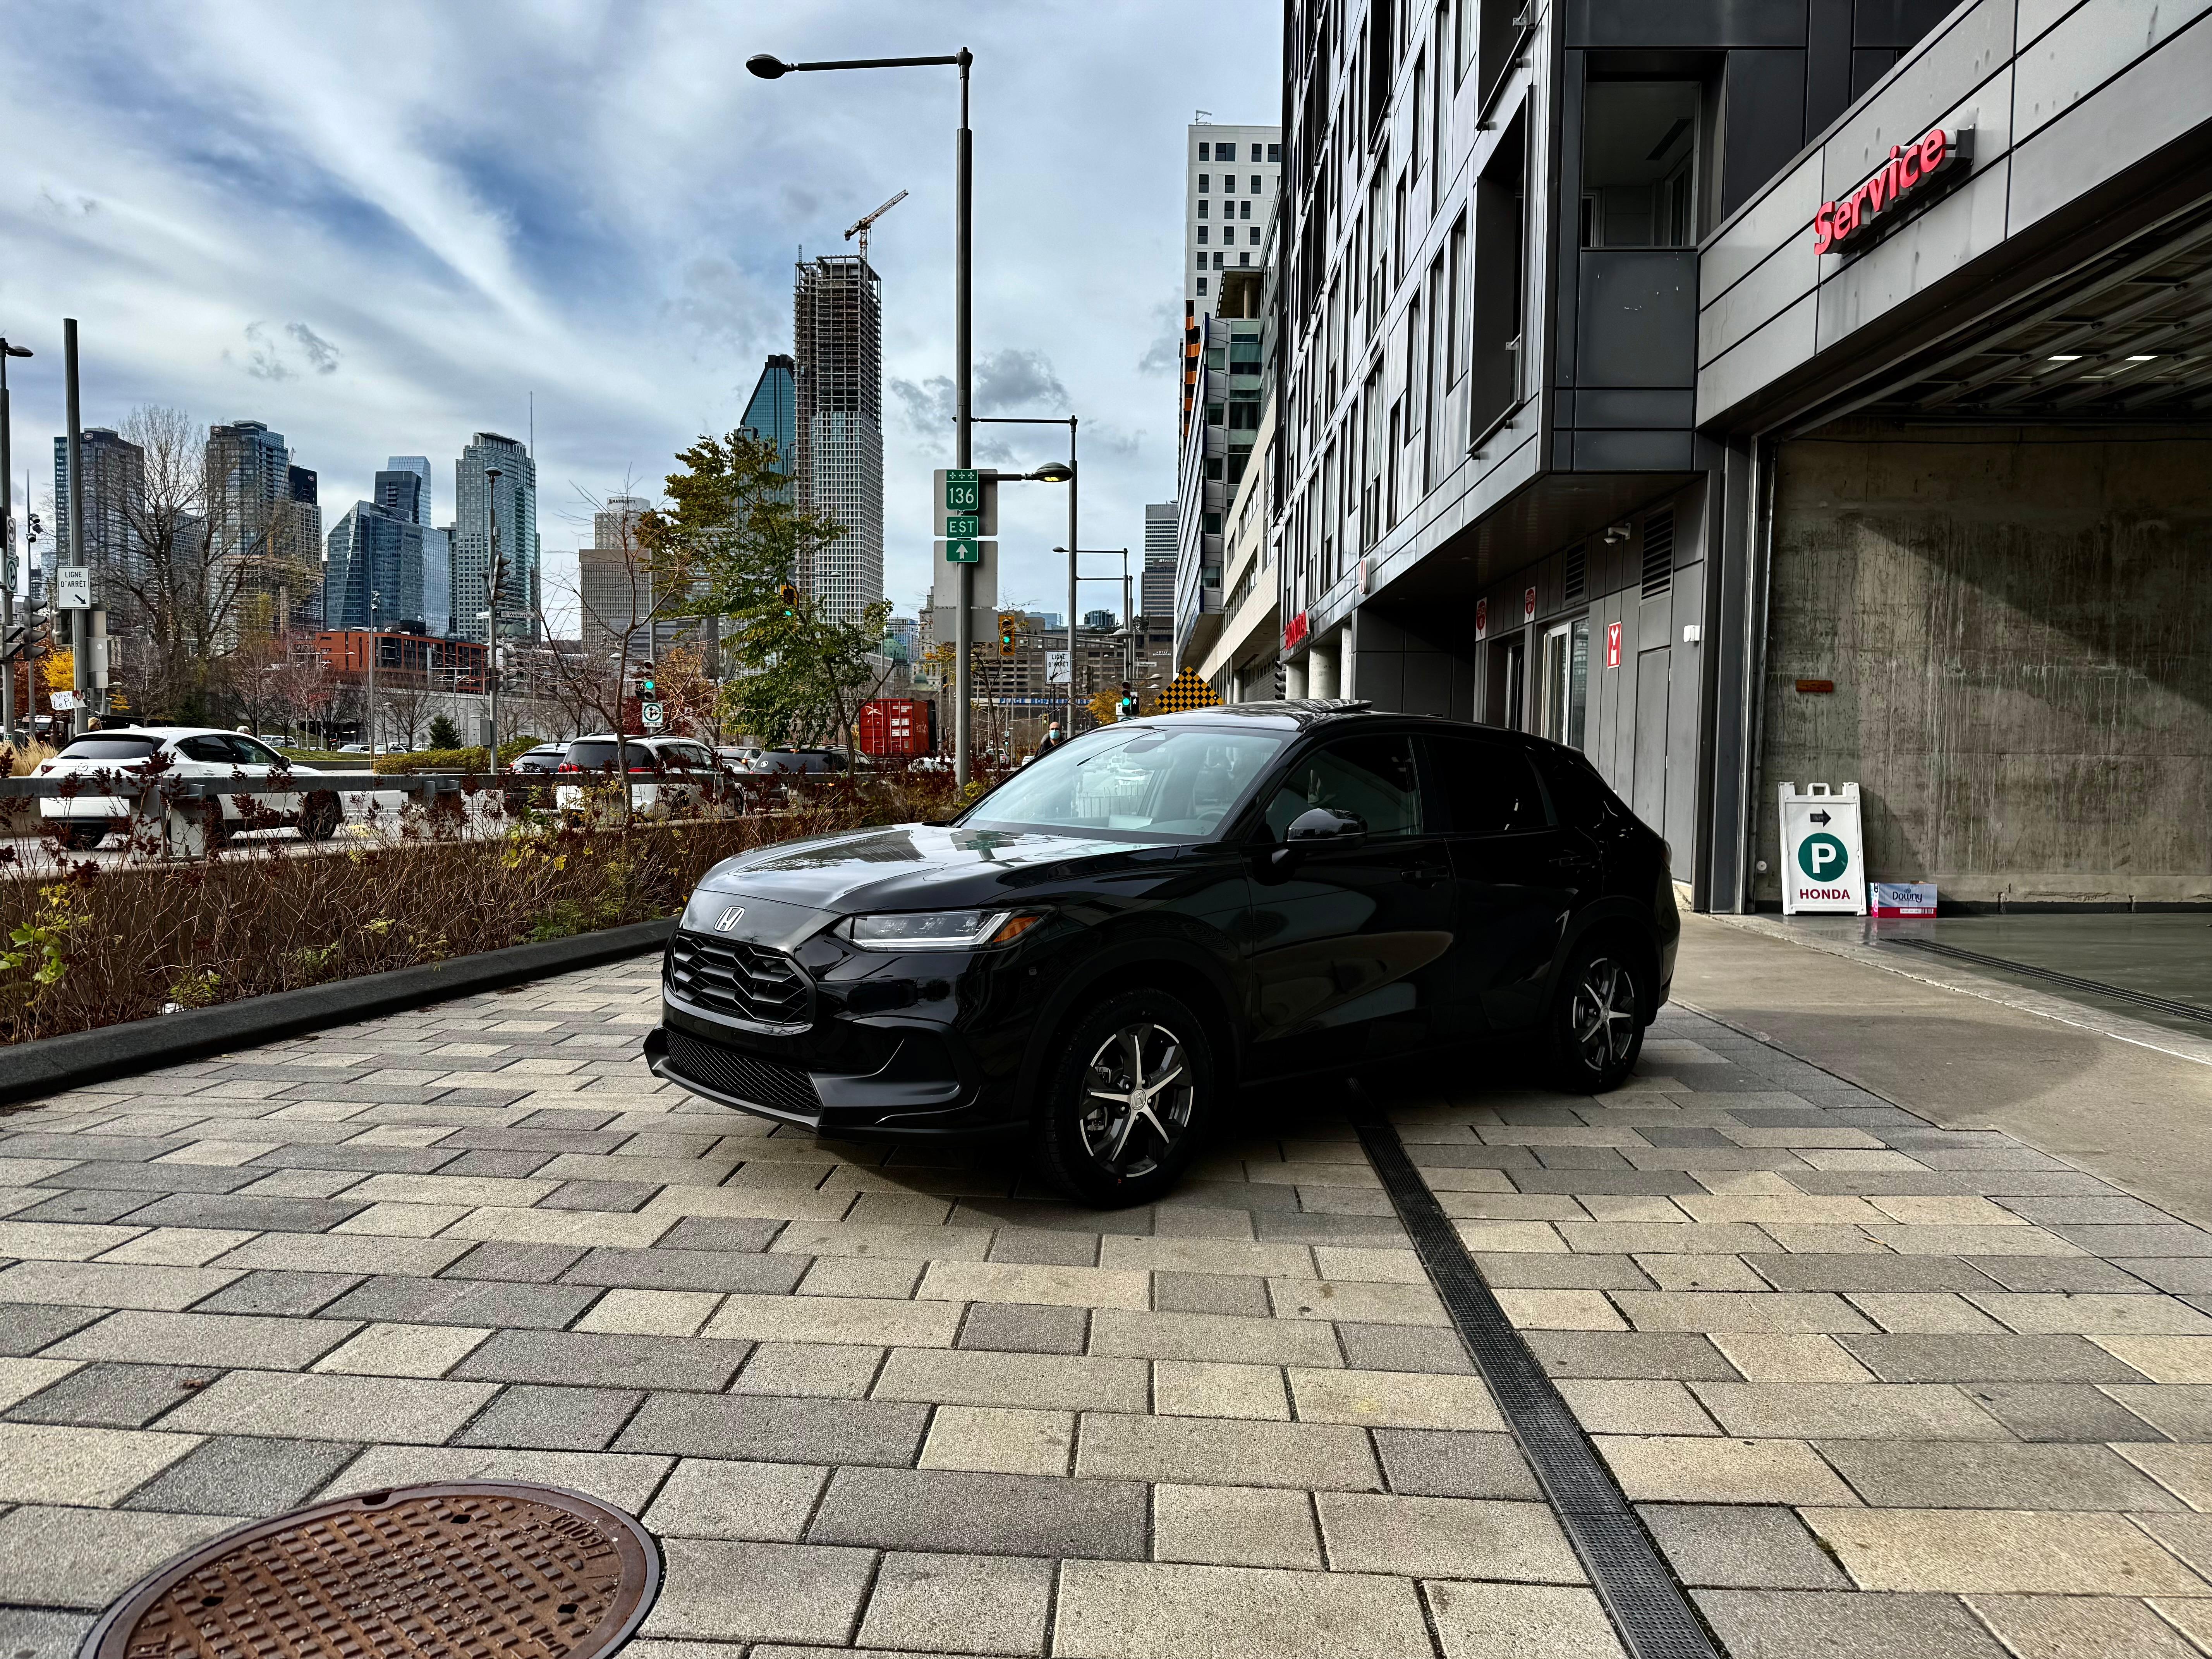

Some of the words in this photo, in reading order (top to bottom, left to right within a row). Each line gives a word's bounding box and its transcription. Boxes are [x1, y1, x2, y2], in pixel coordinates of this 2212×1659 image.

[1814, 129, 1946, 256] Service
[950, 488, 974, 504] 136
[950, 521, 974, 532] EST
[1285, 610, 1307, 651] HONDA
[1811, 843, 1836, 874] P
[1800, 889, 1850, 899] HONDA
[1893, 891, 1922, 903] Downy
